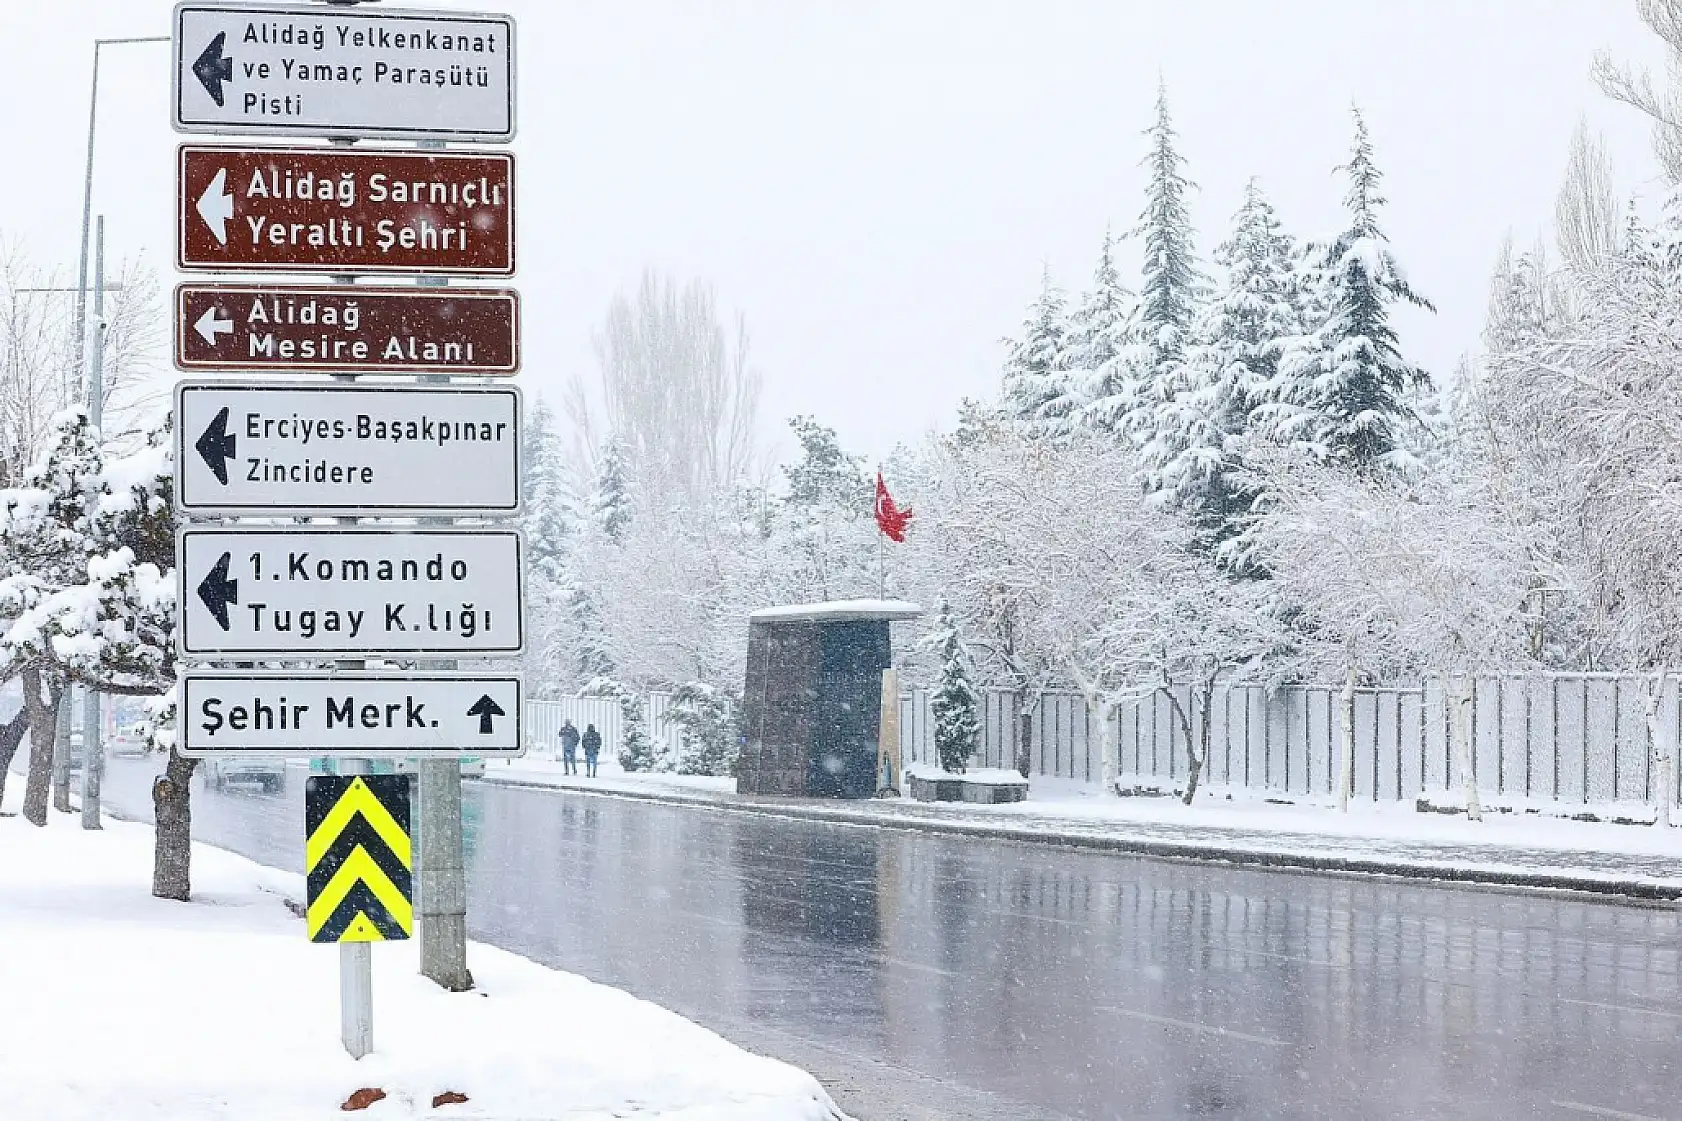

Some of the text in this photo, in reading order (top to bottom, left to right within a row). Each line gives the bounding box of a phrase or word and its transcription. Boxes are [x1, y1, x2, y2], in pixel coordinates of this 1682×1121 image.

[244, 23, 496, 53] Alidağ Yelkenkanat
[243, 59, 487, 87] ve Yamaç Paraşütü
[245, 93, 301, 115] Pisti
[247, 167, 500, 207] Alidağ Sarnıçlı
[247, 215, 466, 252] Yeraltı Şehri
[248, 299, 358, 330] Alidağ
[248, 332, 473, 360] Mesire Alanı
[247, 459, 373, 484] Zincidere
[248, 603, 490, 638] Tugay K.lığı
[201, 696, 438, 735] Şehir Merk.
